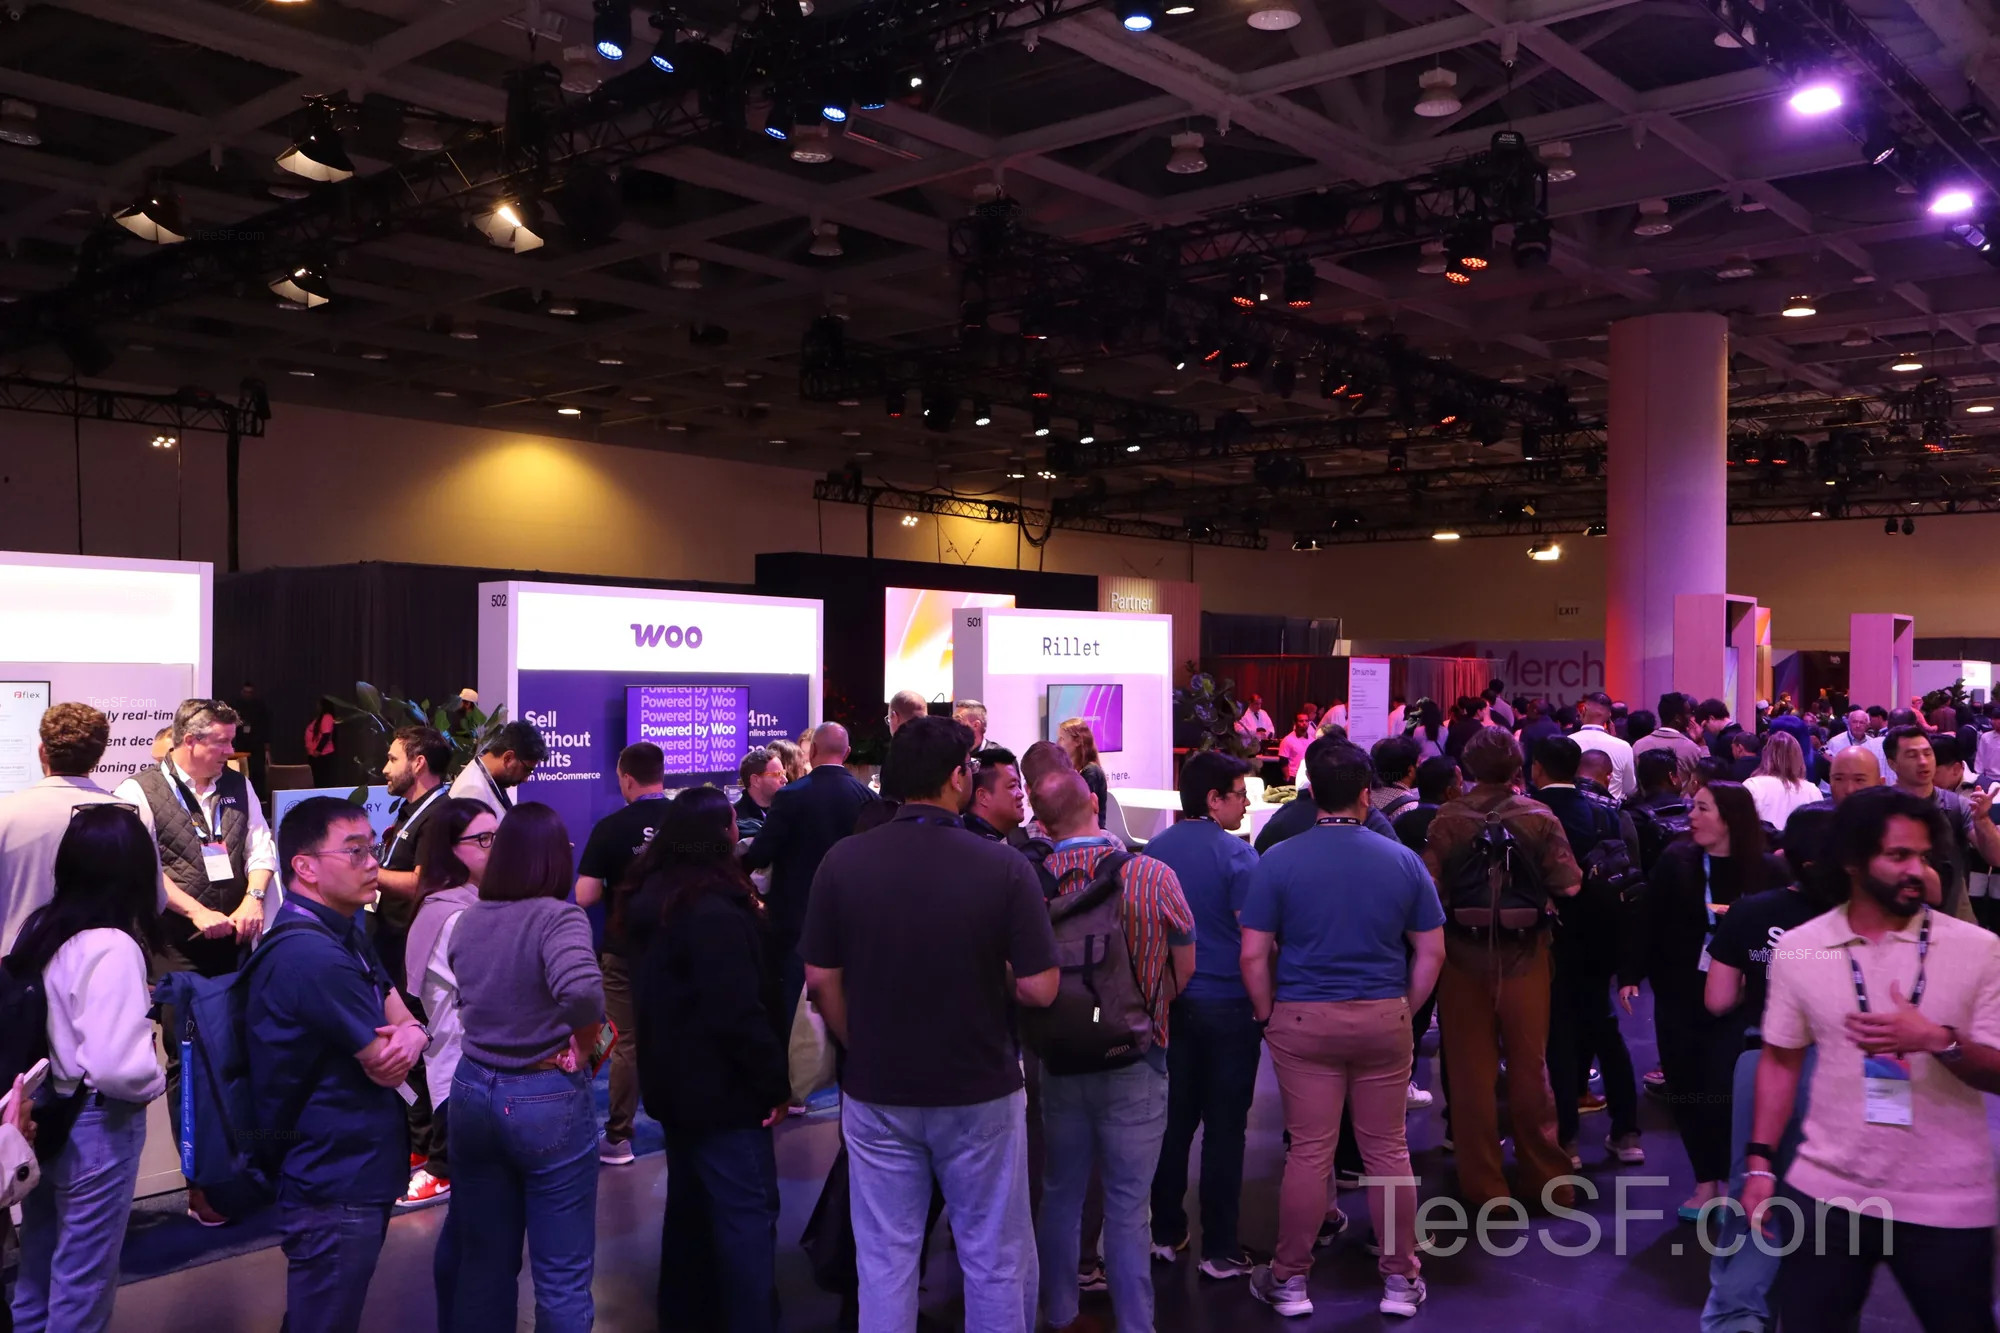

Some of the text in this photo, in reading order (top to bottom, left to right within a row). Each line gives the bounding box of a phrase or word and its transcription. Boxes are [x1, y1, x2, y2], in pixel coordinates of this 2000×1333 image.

[491, 594, 507, 607] 502
[1111, 592, 1153, 611] Partner
[1558, 607, 1580, 616] EXIT
[967, 617, 981, 627] 501
[1042, 637, 1100, 656] Rillet
[1485, 650, 1605, 687] Merch
[22, 690, 40, 699] flex
[641, 694, 736, 710] Powered by Woo
[122, 710, 174, 721] real-tim
[525, 710, 557, 728] Sell
[641, 708, 736, 724] Powered by Woo
[641, 722, 736, 739] Powered by Woo
[749, 729, 788, 737] nline stores
[107, 736, 154, 747] ent dec
[694, 737, 708, 752] by
[711, 736, 736, 749] Woo
[694, 751, 708, 766] by
[711, 750, 736, 763] Woo
[537, 771, 602, 781] WooCommerce
[1111, 771, 1131, 781] here.
